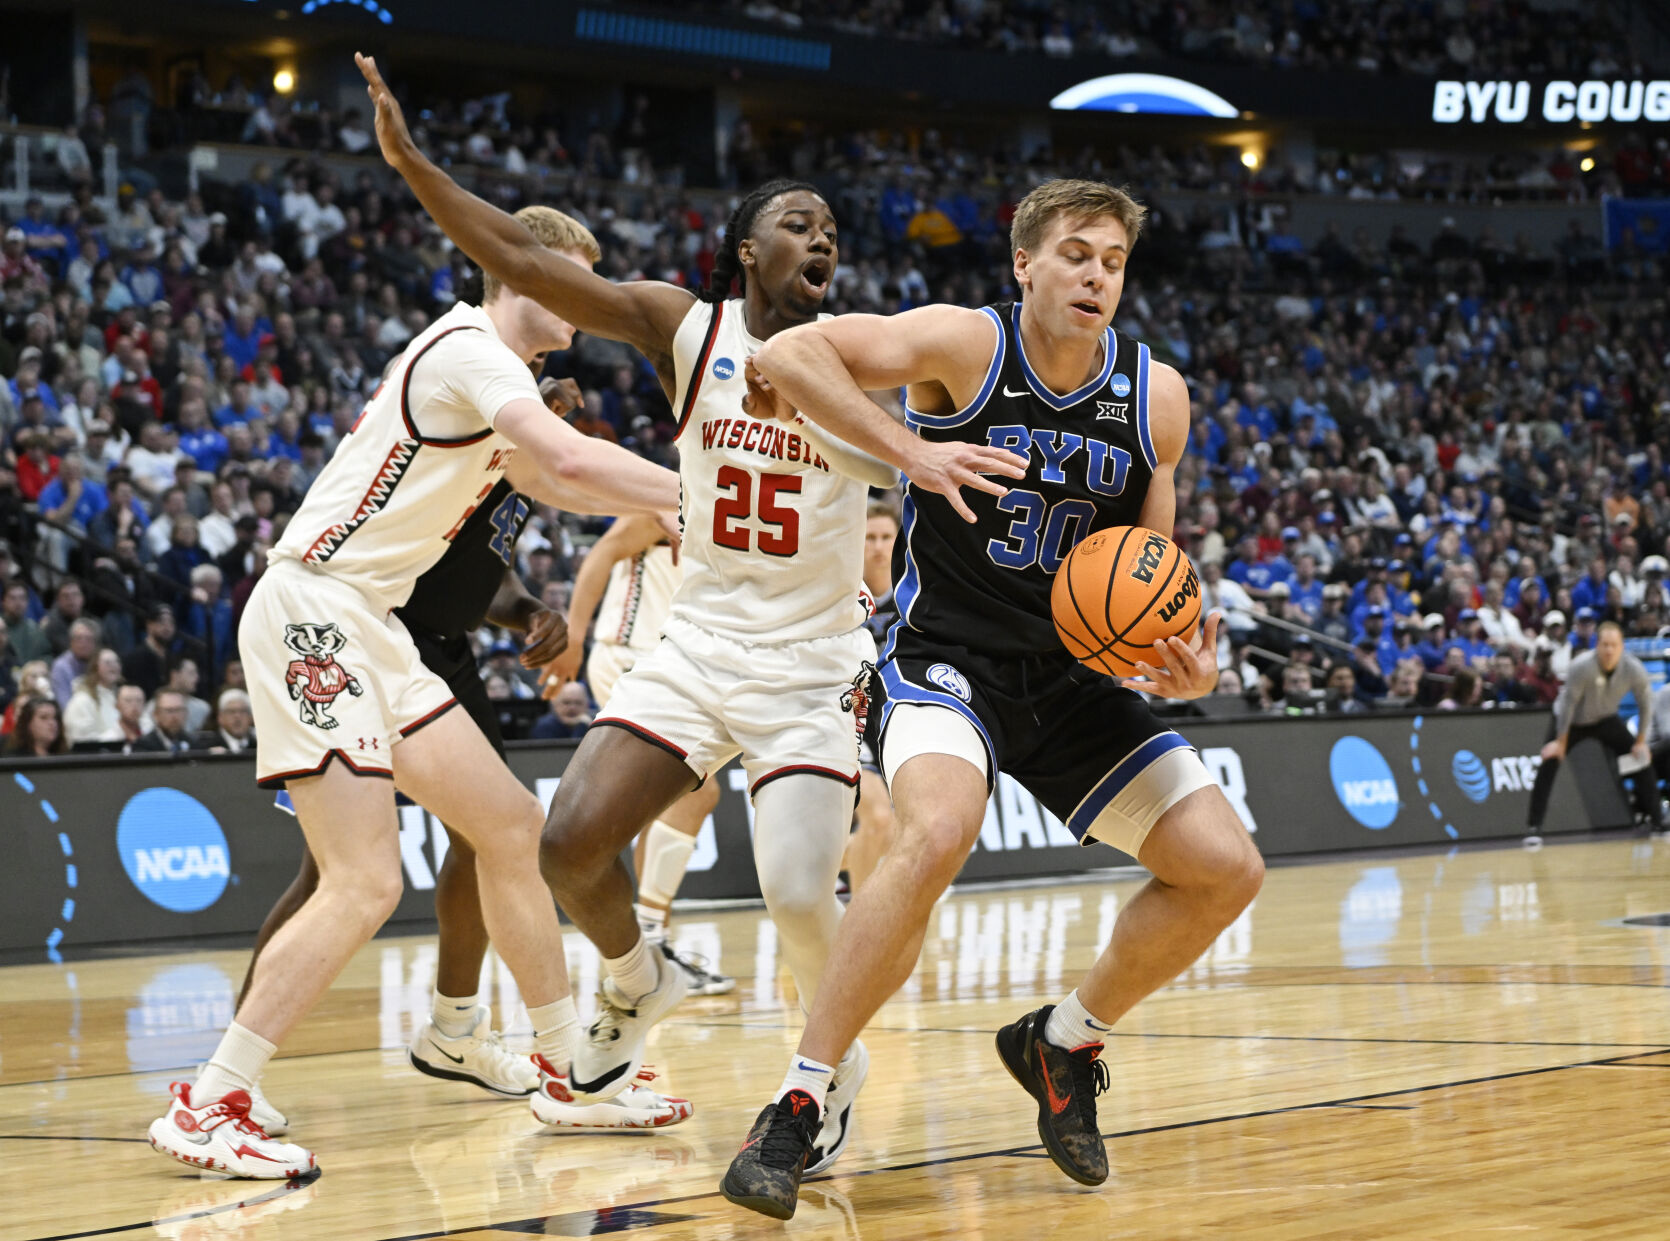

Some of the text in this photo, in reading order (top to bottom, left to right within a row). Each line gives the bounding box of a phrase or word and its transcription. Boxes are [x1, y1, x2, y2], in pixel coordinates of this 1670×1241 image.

[1432, 80, 1670, 123] BYU COUG
[714, 365, 733, 377] NCAA
[1113, 383, 1131, 392] NCAA
[977, 425, 1132, 497] BYU
[713, 465, 802, 557] 25
[986, 488, 1097, 575] 30
[1131, 532, 1169, 585] NCAA
[1157, 559, 1200, 623] ilson
[1343, 779, 1399, 808] NCAA
[1491, 755, 1543, 792] AT&
[135, 844, 230, 883] NCAA
